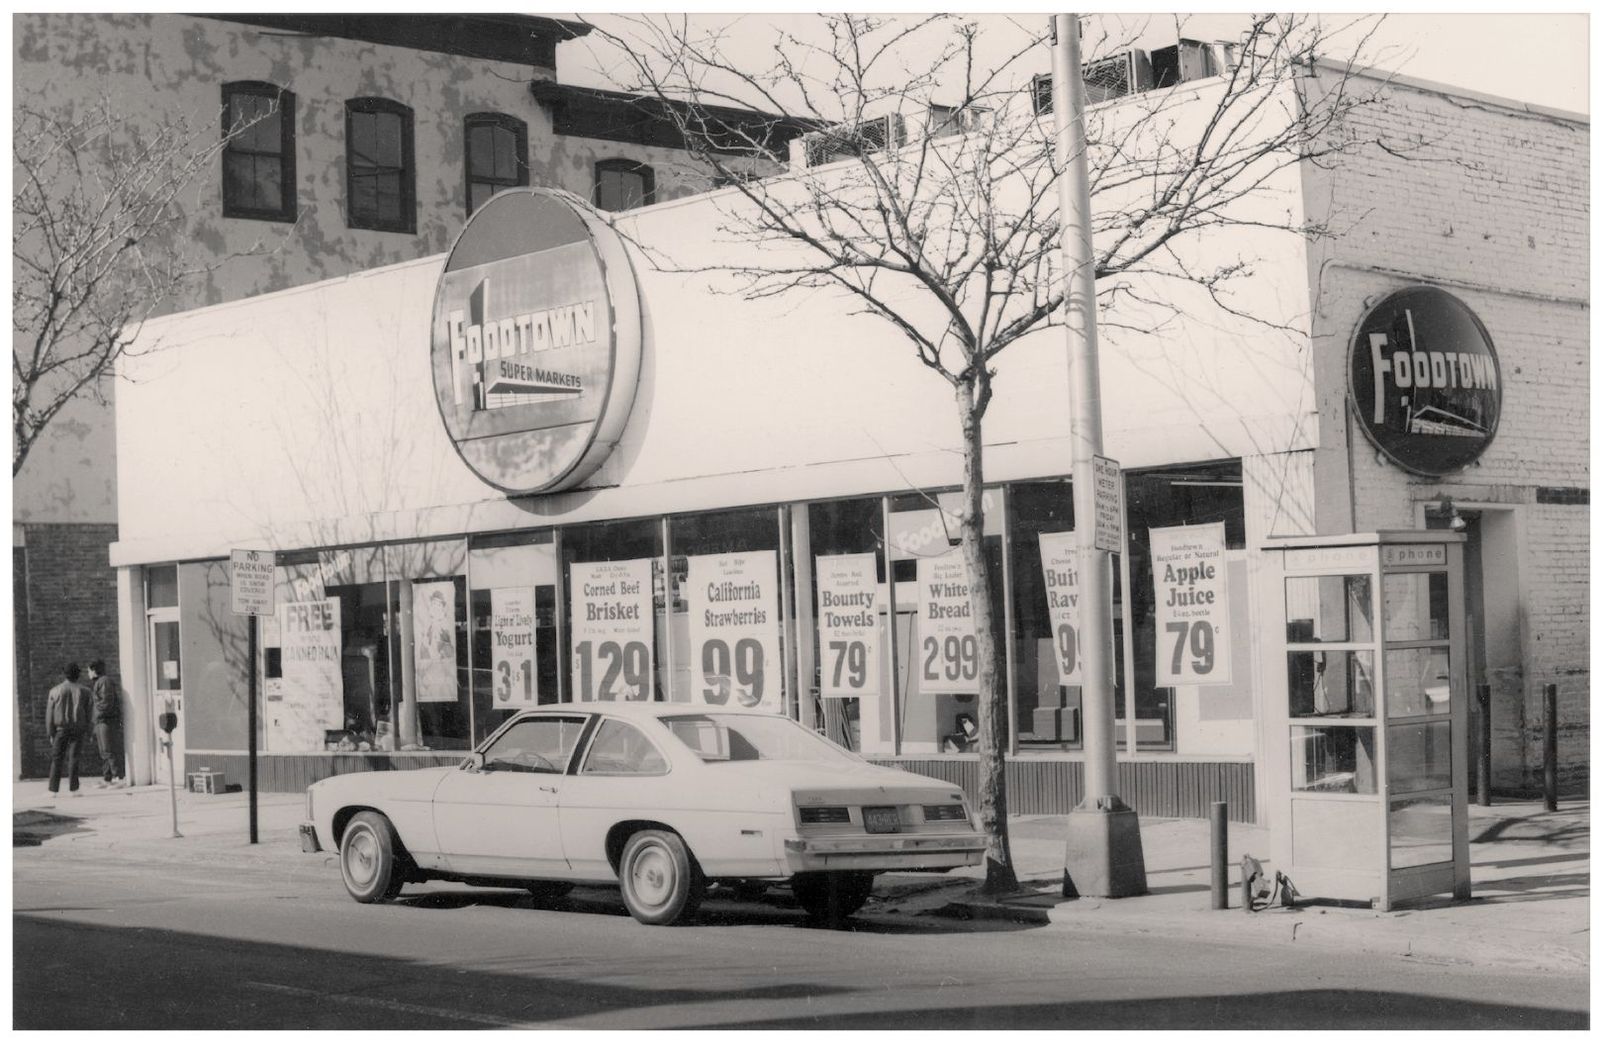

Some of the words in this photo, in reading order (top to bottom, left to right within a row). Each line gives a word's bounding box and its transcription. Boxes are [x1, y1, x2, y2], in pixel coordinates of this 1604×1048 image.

[447, 300, 597, 406] FOODTOWN
[500, 360, 533, 381] SUPER
[535, 367, 581, 388] MARKETS
[1369, 333, 1497, 424] FOODTOWN
[247, 552, 259, 562] NO
[1194, 549, 1220, 559] Natural
[1399, 549, 1442, 562] phone
[233, 561, 273, 574] PARKING
[1163, 561, 1216, 586] Apple
[1046, 568, 1079, 588] Buit
[584, 582, 616, 597] Corned
[620, 580, 640, 595] Beef
[707, 581, 761, 603] California
[929, 582, 968, 599] White
[1166, 586, 1215, 607] Juice
[822, 590, 875, 609] Bounty
[1050, 591, 1079, 609] Rav
[286, 603, 335, 632] FREE
[586, 602, 640, 621] Brisket
[704, 606, 767, 628] Strawberries
[824, 610, 874, 628] Towels
[928, 600, 971, 620] Bread
[495, 631, 533, 650] Yogurt
[1058, 623, 1081, 675] 9
[497, 660, 511, 702] 3
